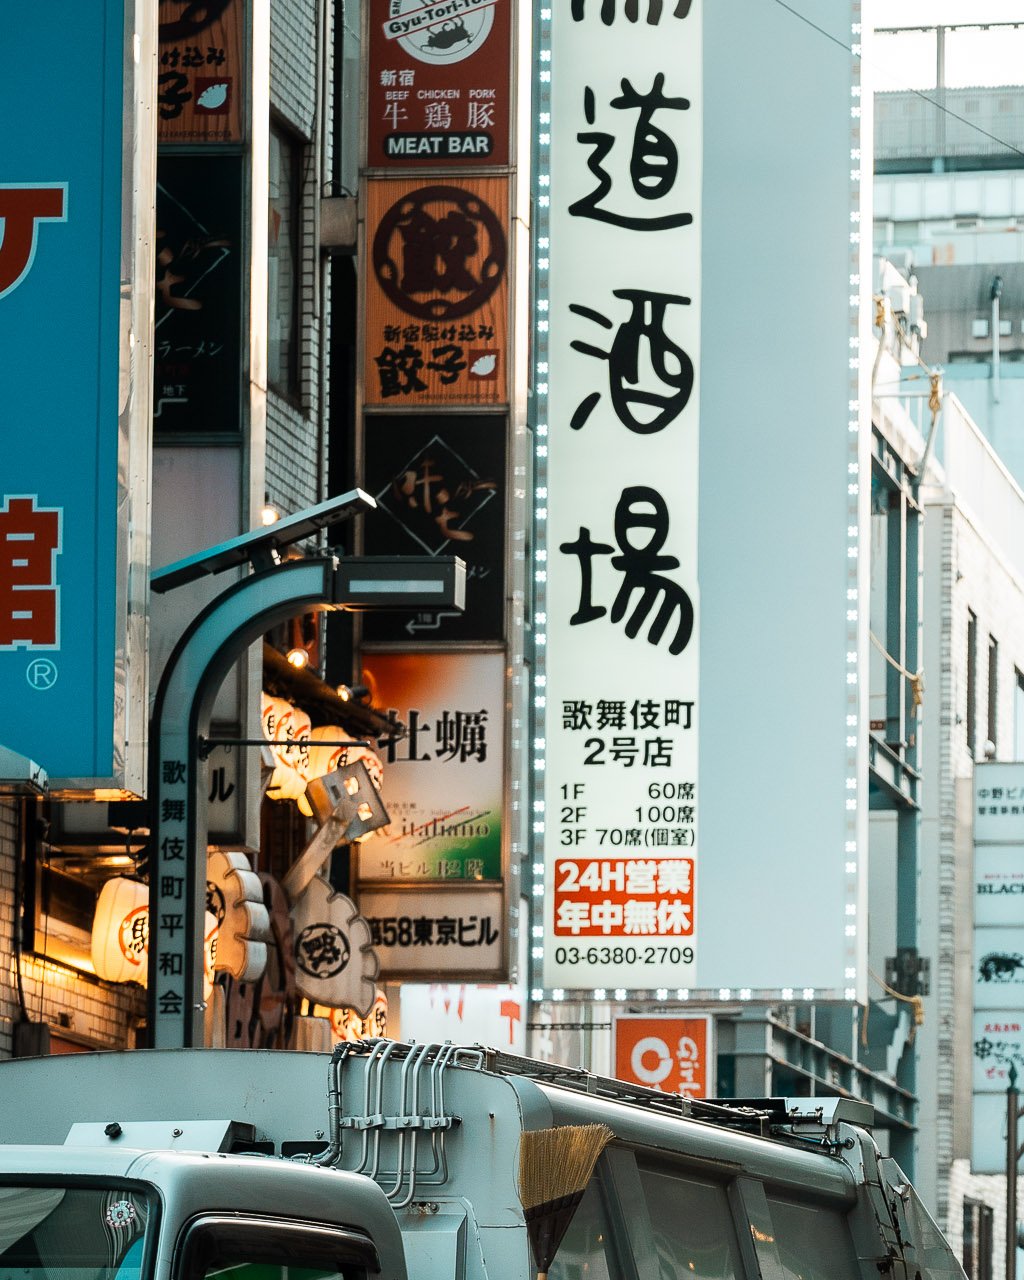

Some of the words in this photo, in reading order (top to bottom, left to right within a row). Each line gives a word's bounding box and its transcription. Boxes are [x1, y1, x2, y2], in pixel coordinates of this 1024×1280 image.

[380, 69, 415, 87] 新宿
[385, 91, 409, 101] BEEF
[417, 90, 460, 99] CHICKEN
[469, 89, 496, 99] PORK
[382, 102, 409, 130] 牛
[424, 102, 452, 130] 鶏
[467, 102, 495, 129] 豚
[388, 137, 443, 155] MEAT
[448, 136, 490, 153] BAR
[559, 0, 696, 656] 道酒場
[562, 699, 695, 732] 歌舞伎町
[377, 709, 489, 763] 牡蠣
[583, 738, 673, 768] 2号店
[560, 783, 585, 801] 1F
[648, 782, 696, 801] 60席
[560, 807, 587, 823] 2F
[634, 806, 696, 823] 100席
[560, 829, 587, 846] 3F
[596, 827, 696, 847] 70席(個室)
[159, 760, 188, 1018] 歌舞伎町平和会
[557, 861, 693, 894] 24H営業
[557, 900, 693, 937] 年中無休
[555, 945, 695, 966] 03-6380-2709
